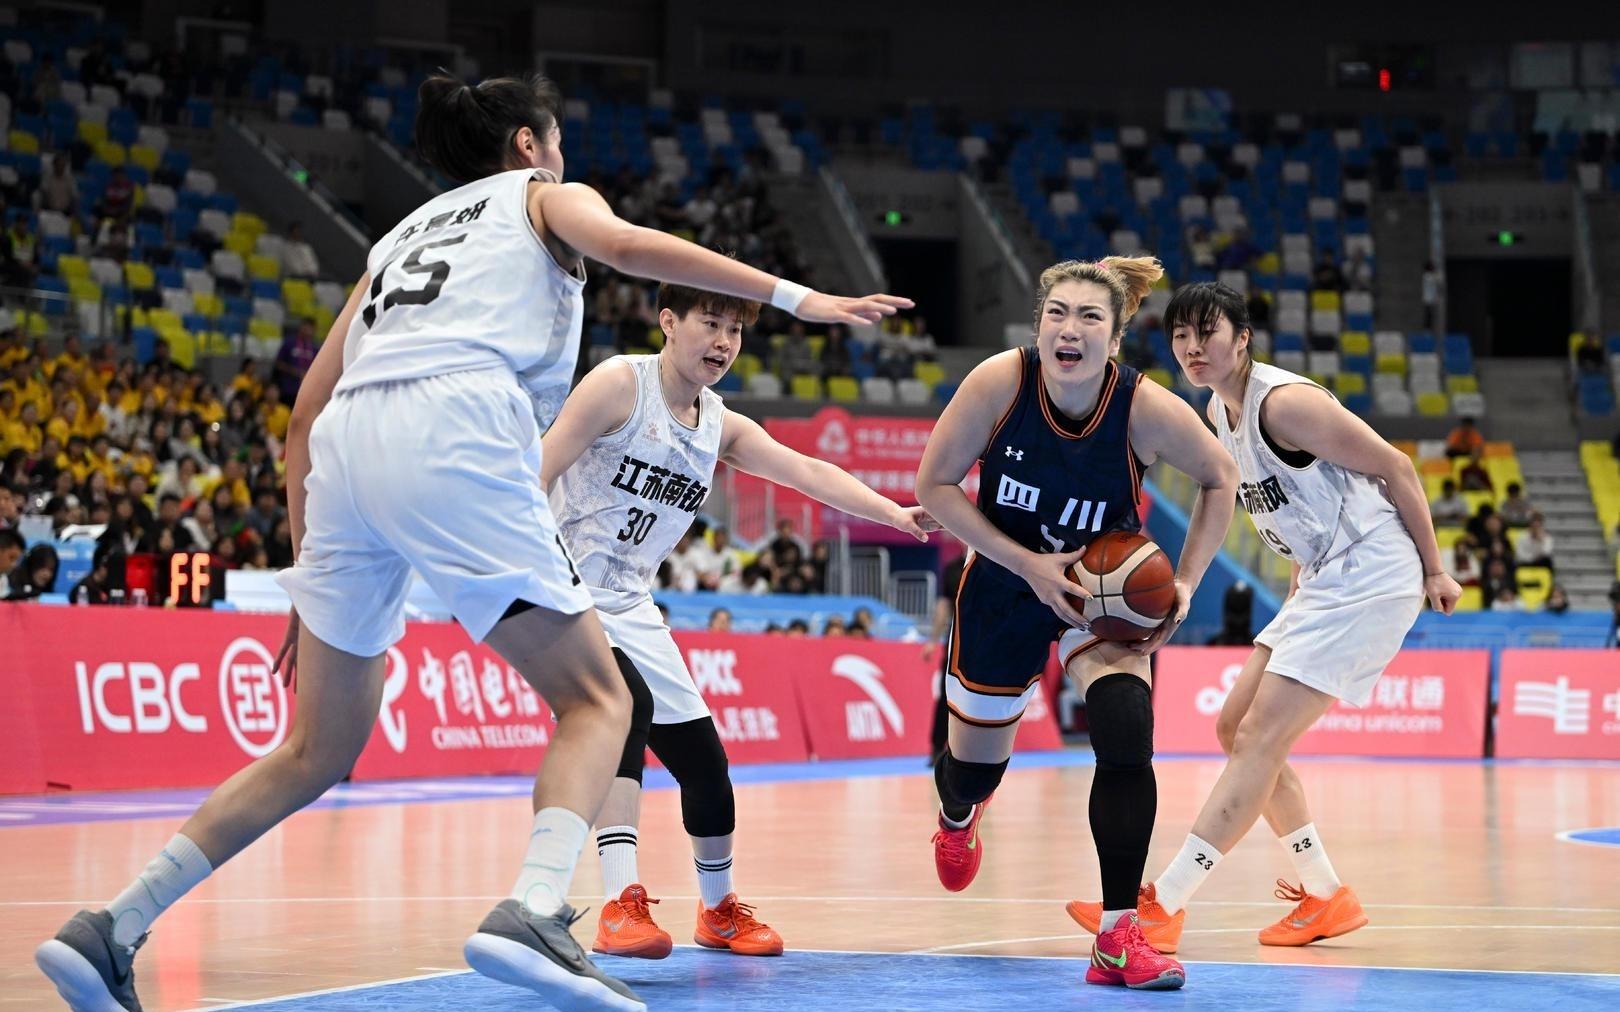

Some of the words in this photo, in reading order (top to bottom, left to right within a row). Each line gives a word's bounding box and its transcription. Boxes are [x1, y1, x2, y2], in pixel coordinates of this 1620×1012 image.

[362, 232, 468, 330] 15
[610, 455, 708, 516] 江苏南钢
[1238, 475, 1289, 515] 苏南钢
[617, 506, 657, 546] 30
[418, 647, 540, 724] 中国电信
[688, 649, 743, 696] PICC
[75, 660, 208, 734] ICBC
[432, 725, 482, 750] CHINA
[479, 724, 548, 749] TELECOM
[845, 700, 886, 742] ANTA
[1365, 714, 1443, 732] unicom
[1195, 853, 1214, 871] 23
[1292, 837, 1312, 853] 23
